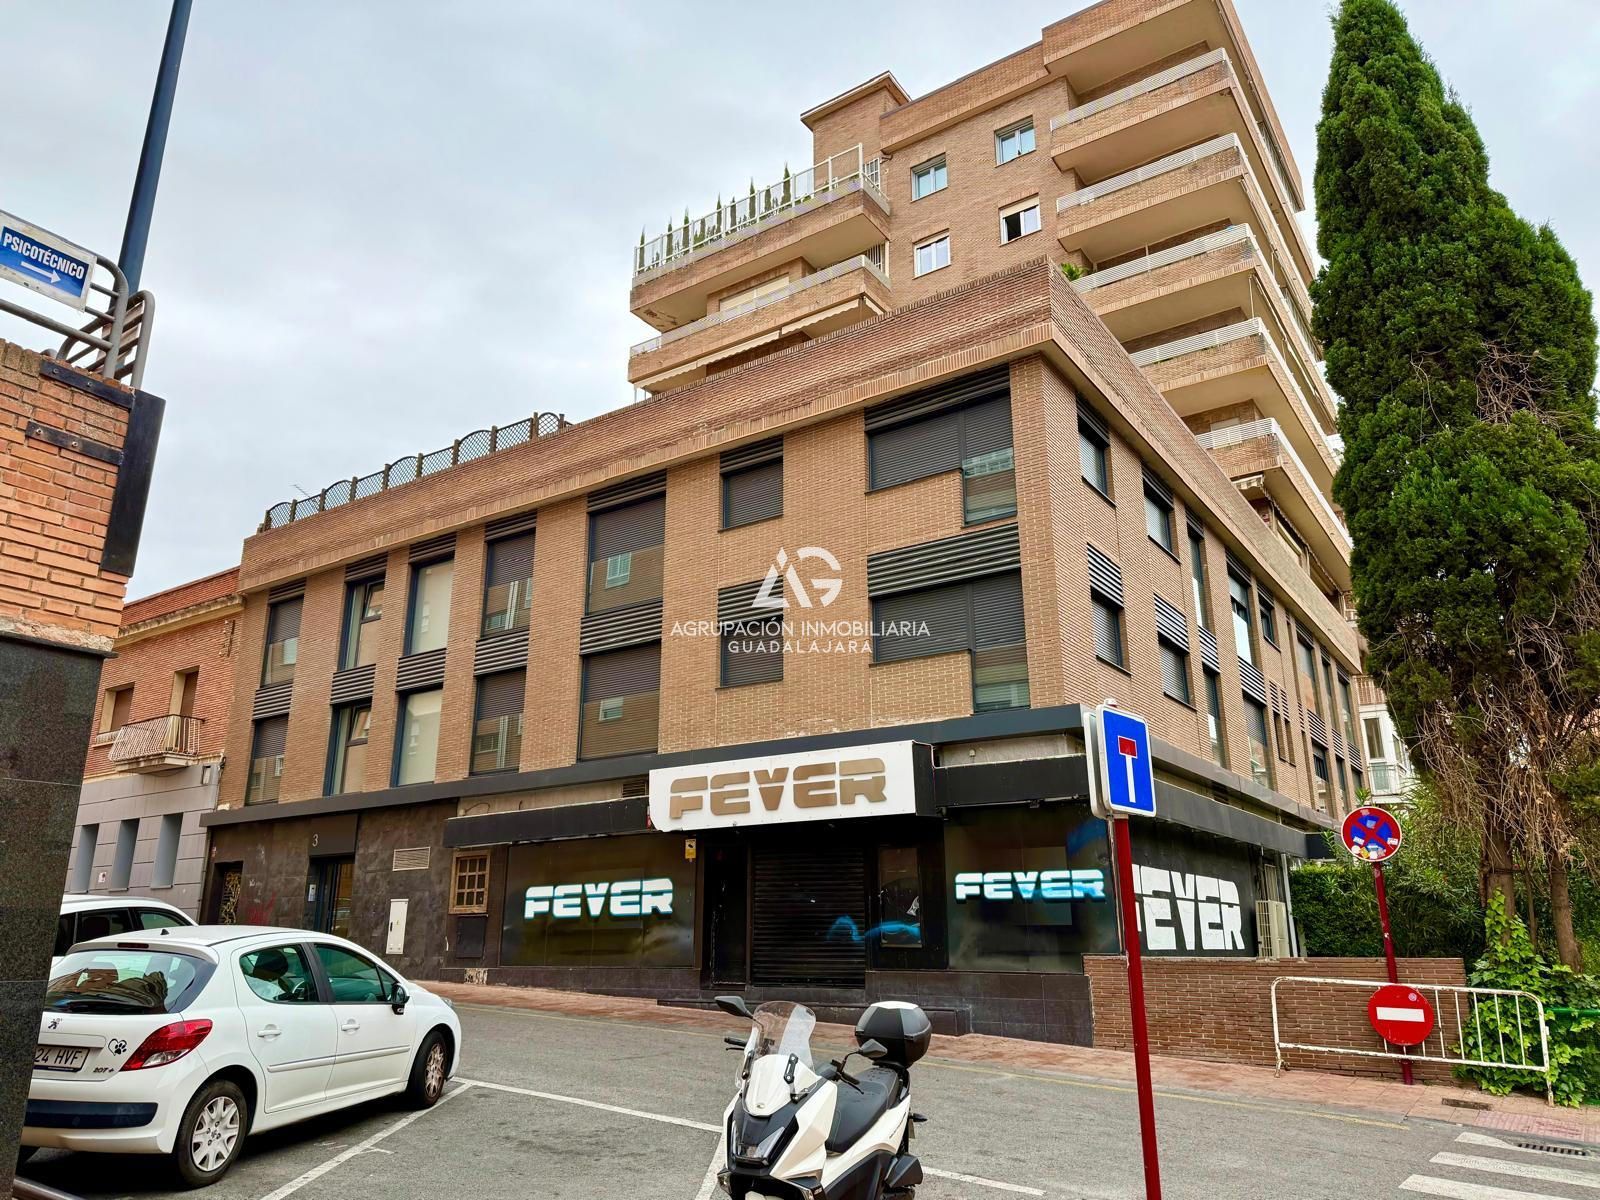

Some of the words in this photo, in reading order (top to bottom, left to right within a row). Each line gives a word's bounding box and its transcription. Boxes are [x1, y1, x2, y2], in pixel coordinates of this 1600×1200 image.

[3, 232, 85, 280] PSICOTÉCNICO
[669, 757, 888, 820] FEVER
[312, 833, 319, 847] 3
[524, 878, 673, 920] FEVER
[955, 869, 1106, 900] FEVER
[53, 1049, 83, 1066] HVF
